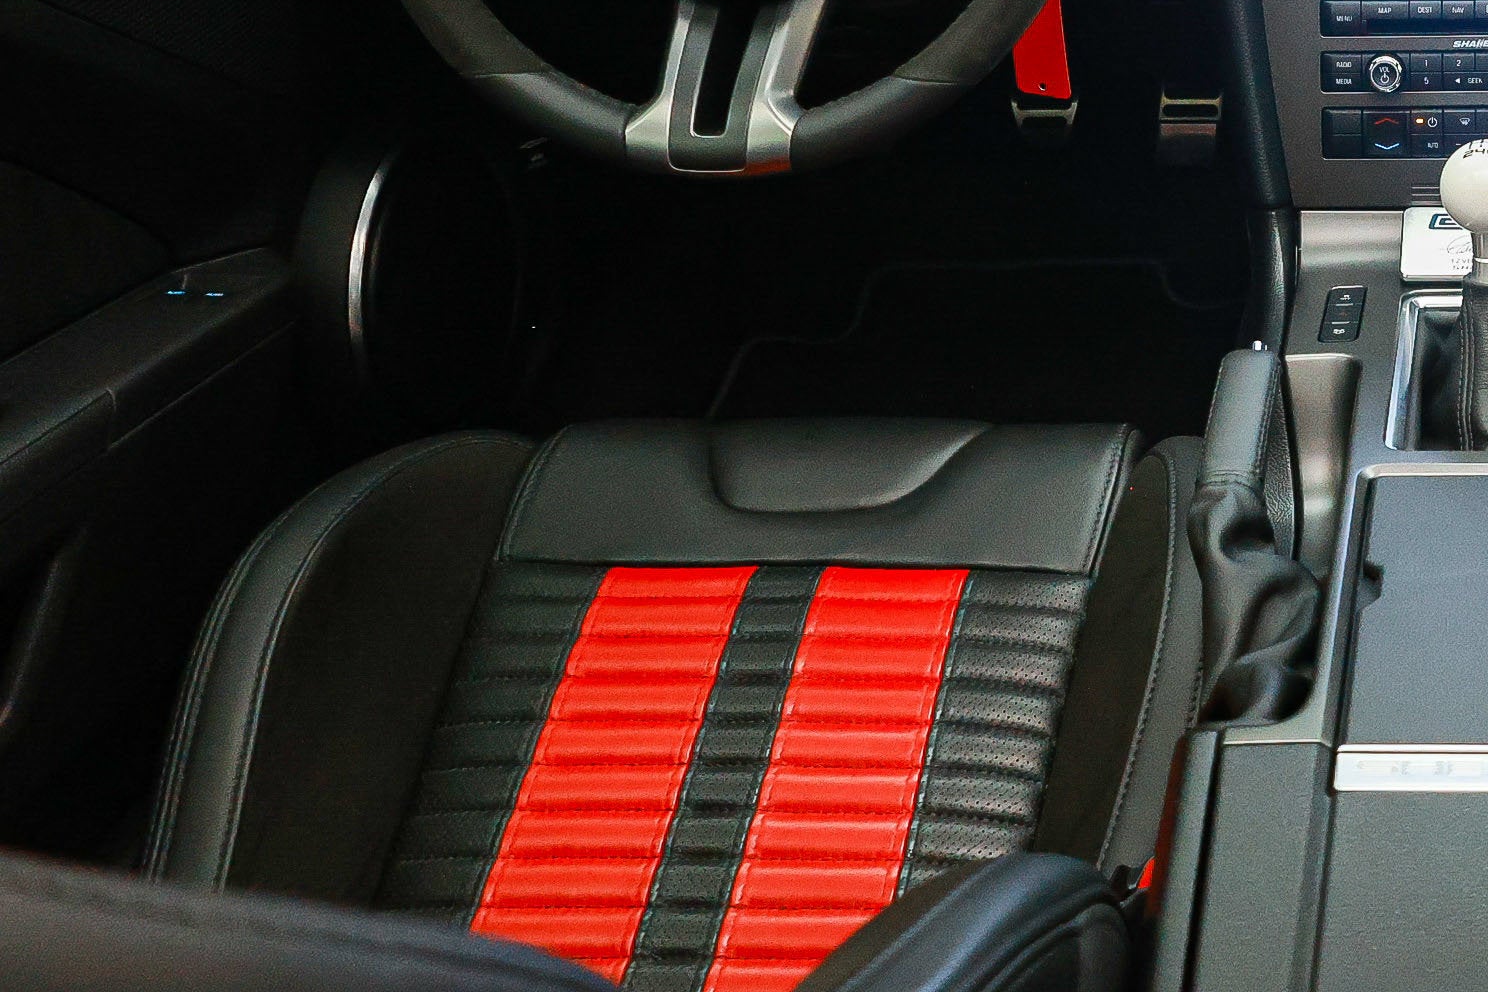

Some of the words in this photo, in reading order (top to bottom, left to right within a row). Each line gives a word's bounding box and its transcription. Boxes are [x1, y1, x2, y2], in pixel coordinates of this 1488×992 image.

[1377, 6, 1392, 14] MAP
[1417, 6, 1433, 14] DEST
[1451, 6, 1465, 14] NAV
